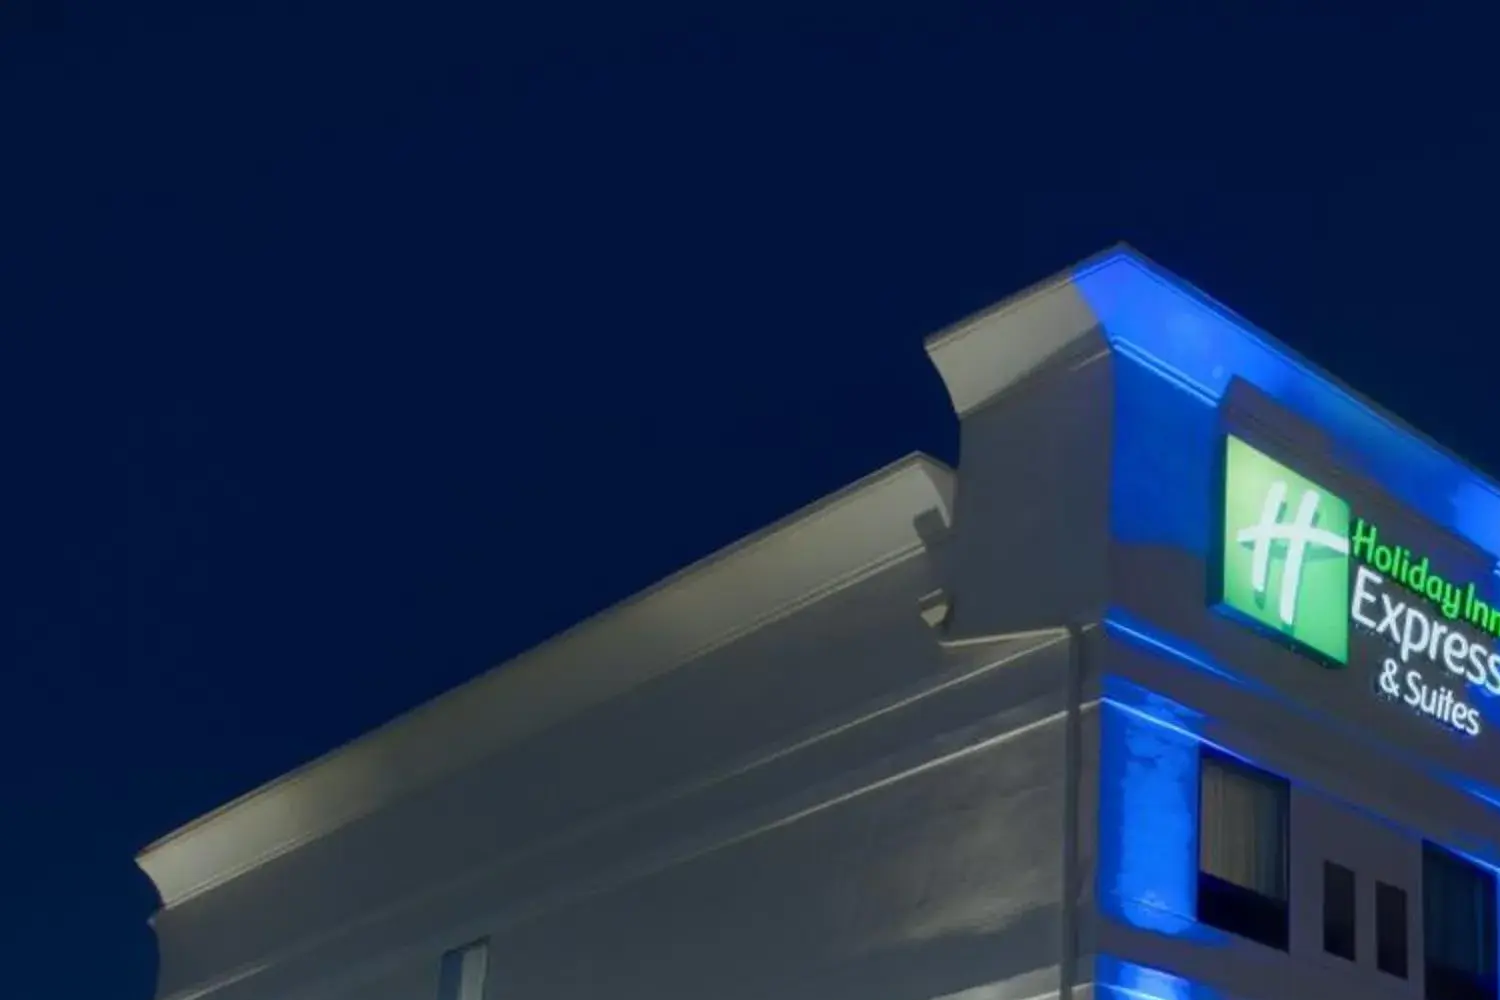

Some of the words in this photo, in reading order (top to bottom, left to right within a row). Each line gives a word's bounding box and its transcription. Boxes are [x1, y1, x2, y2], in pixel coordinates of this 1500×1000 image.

[1351, 518, 1461, 618] Holiday
[1378, 658, 1401, 697] &
[1403, 670, 1481, 736] Suites
